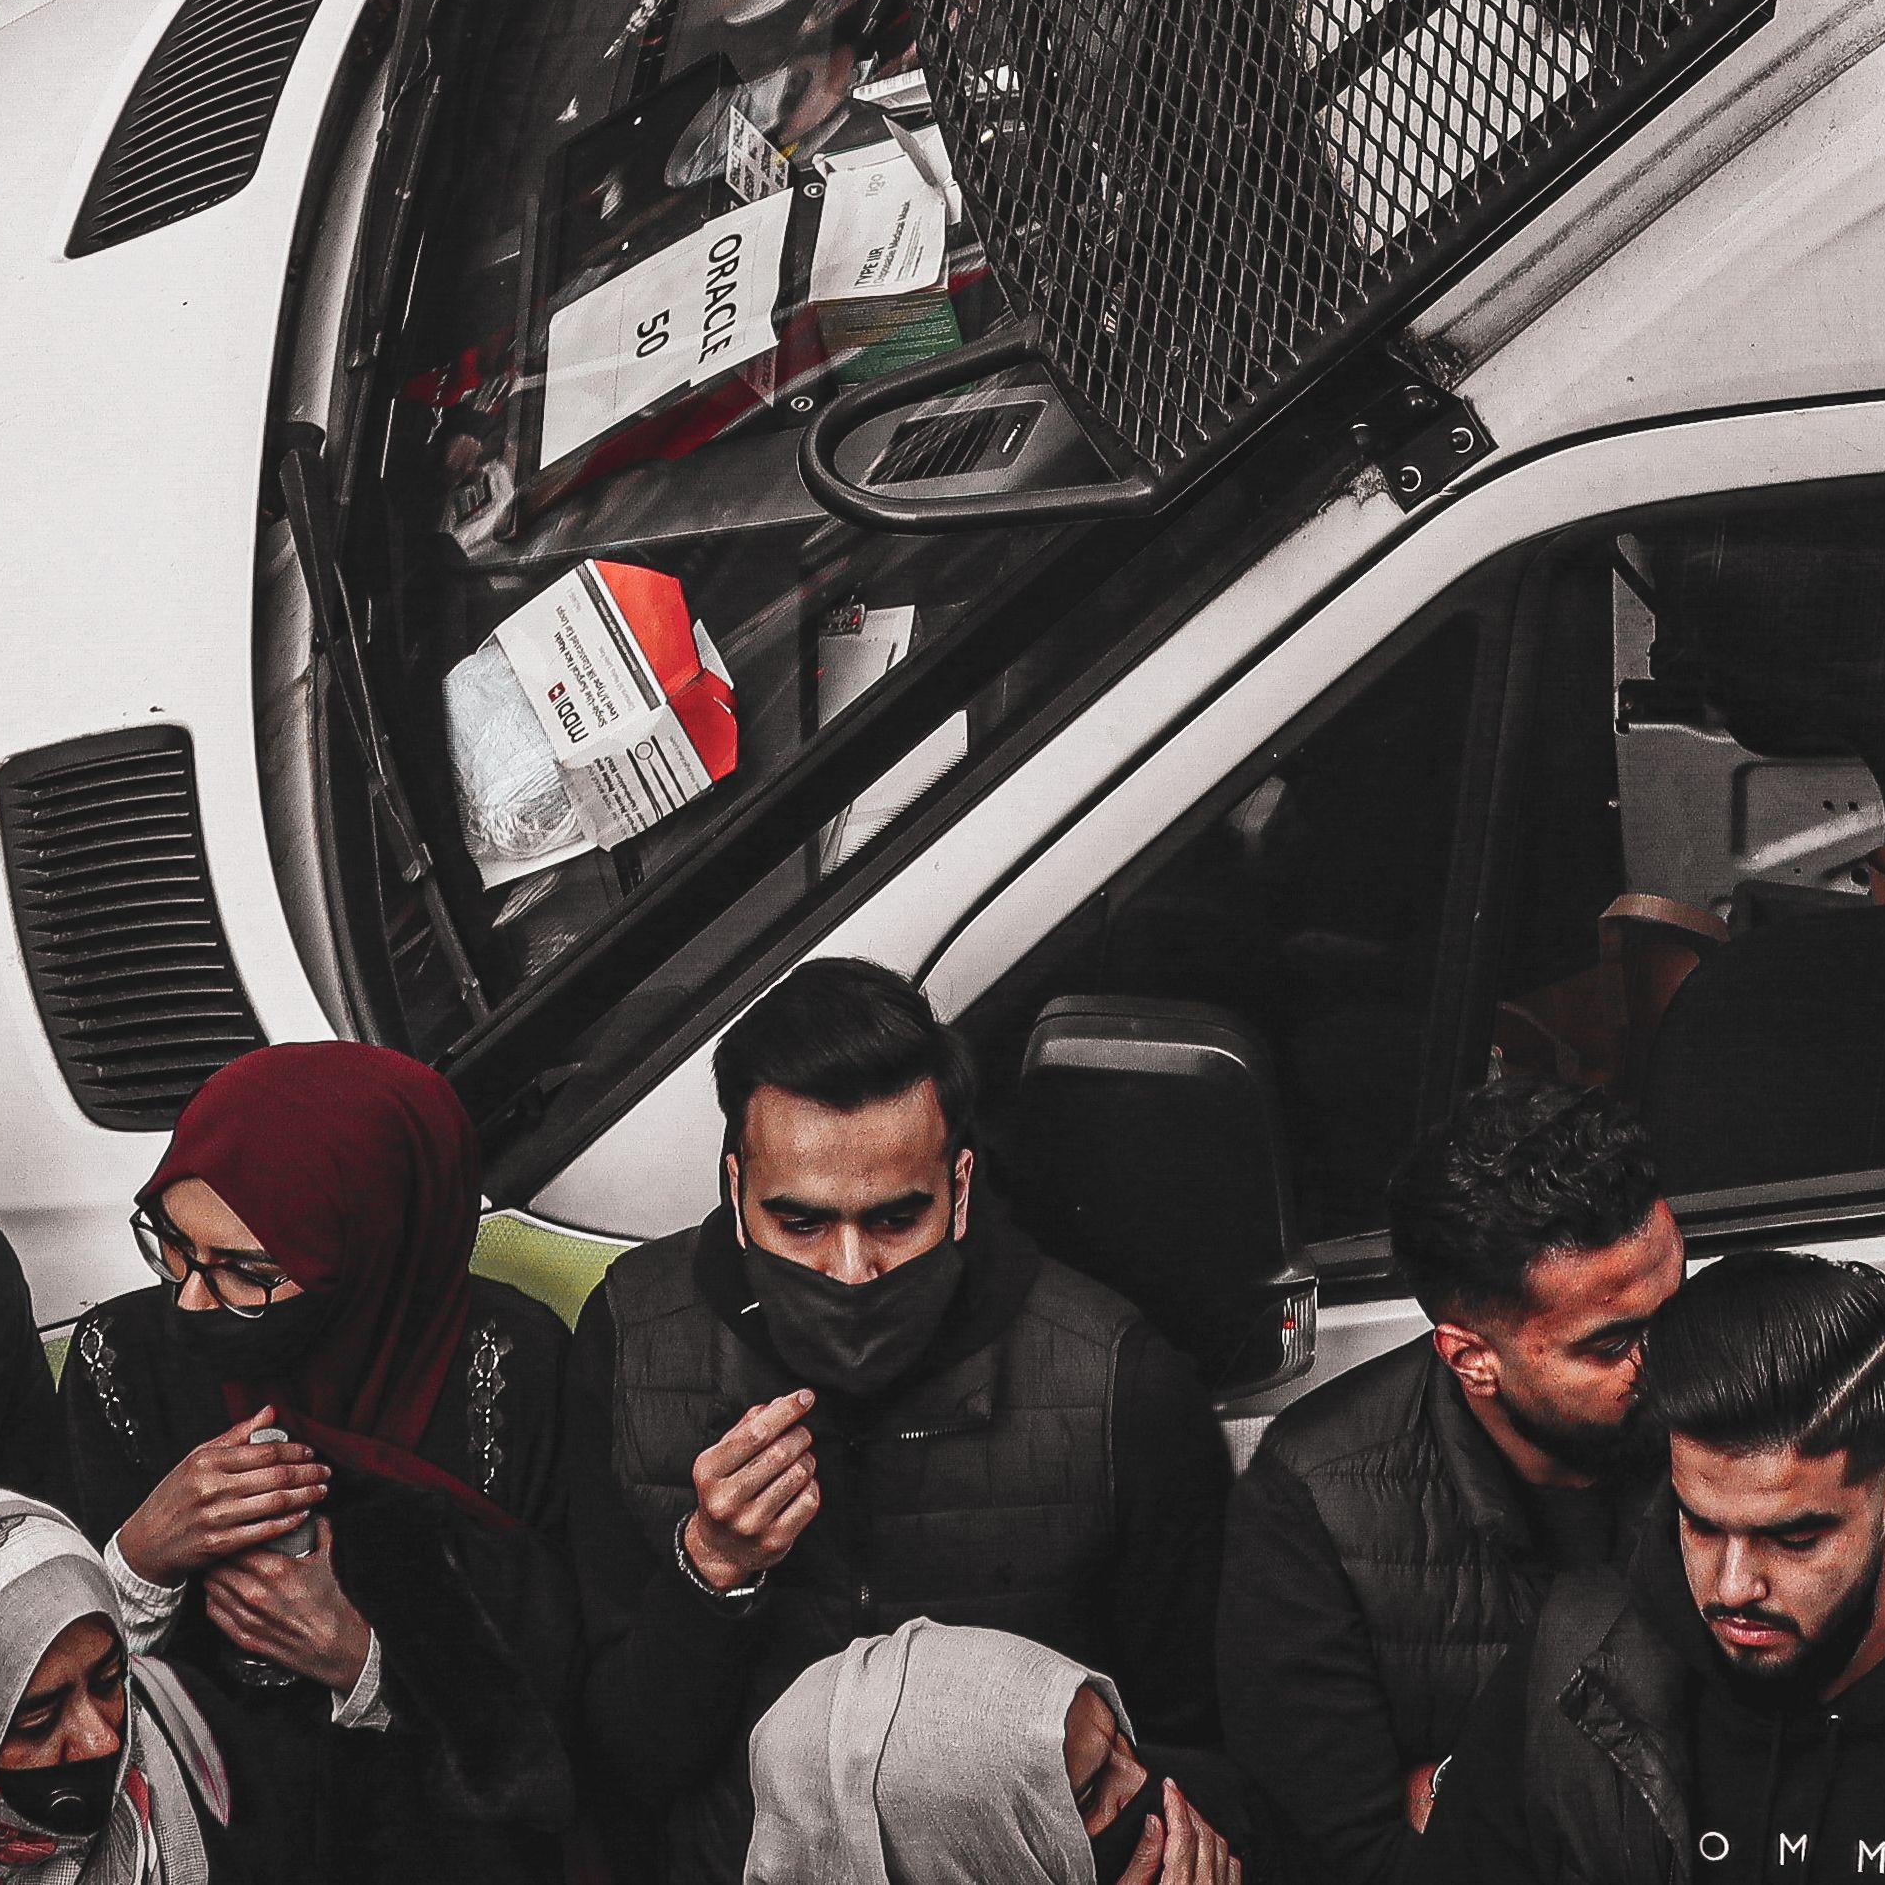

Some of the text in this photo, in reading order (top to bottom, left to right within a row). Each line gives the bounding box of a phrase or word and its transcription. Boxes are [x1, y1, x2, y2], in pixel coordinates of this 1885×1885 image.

[898, 200, 911, 221] Mask
[855, 260, 878, 287] TYPE
[698, 232, 742, 364] ORACLE
[634, 308, 670, 361] 50
[554, 604, 571, 626] Loops
[553, 631, 568, 653] Masks
[562, 650, 576, 667] Face
[603, 699, 619, 721] Level
